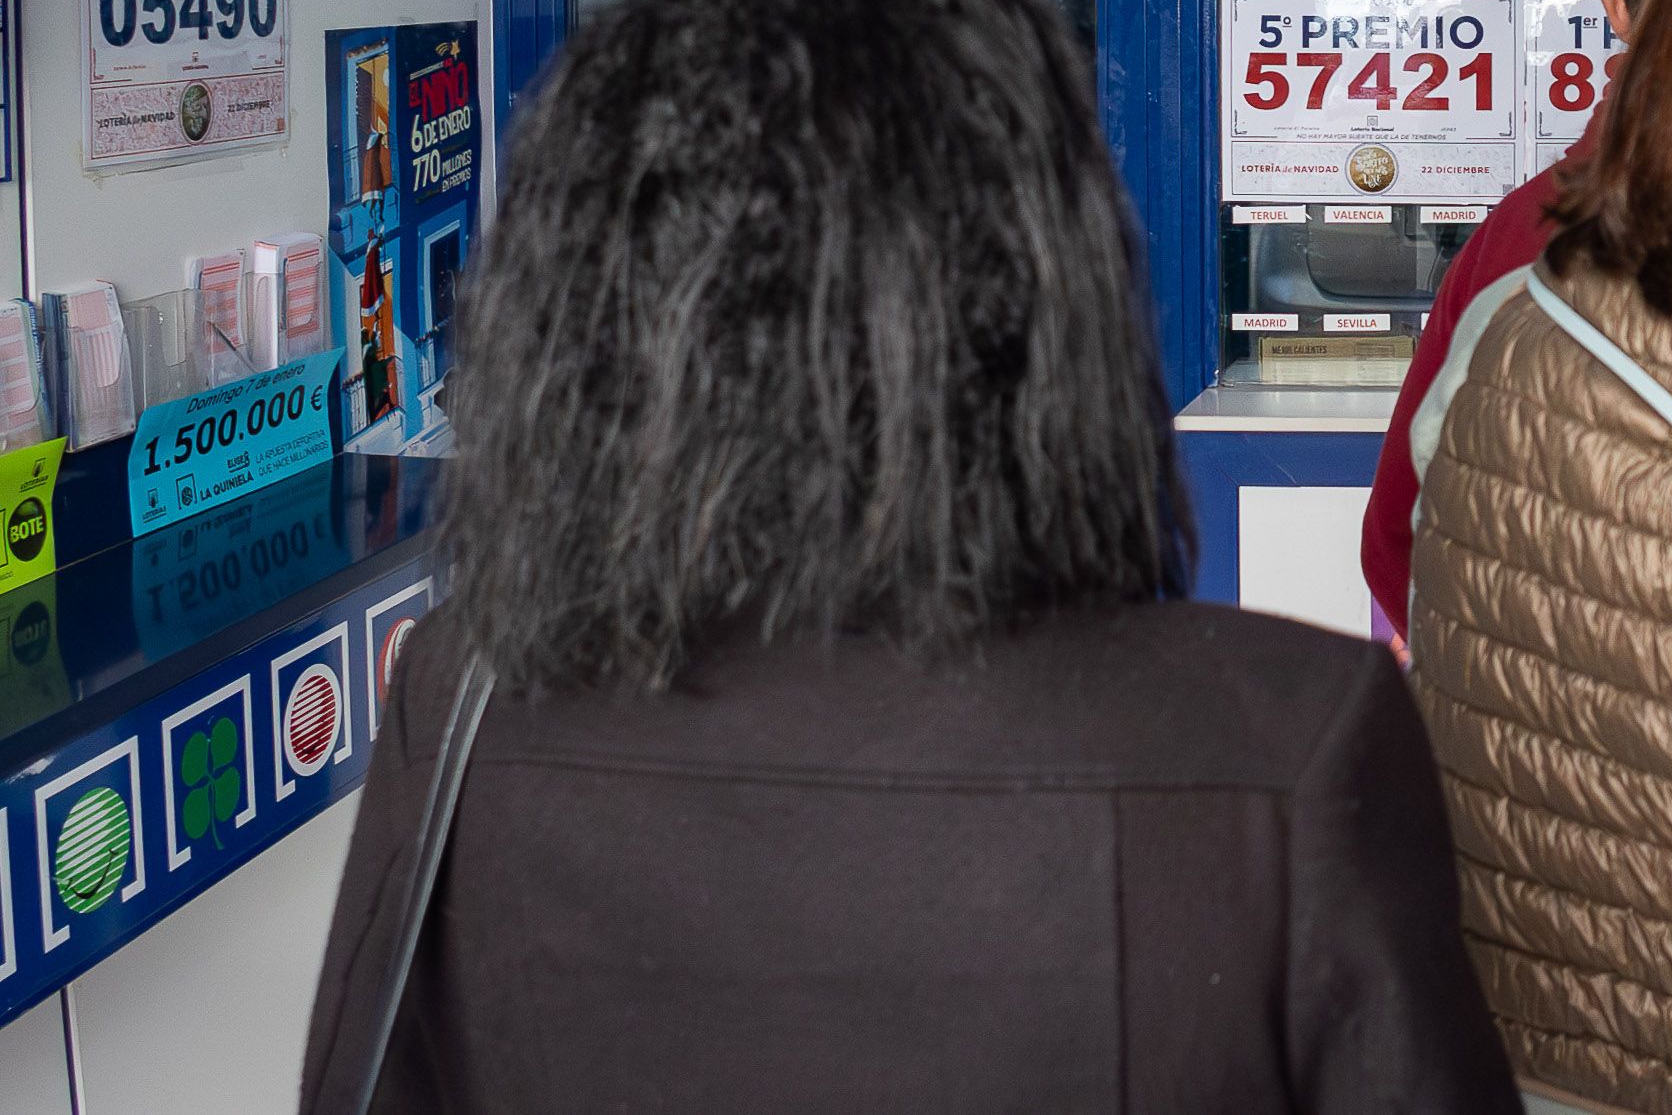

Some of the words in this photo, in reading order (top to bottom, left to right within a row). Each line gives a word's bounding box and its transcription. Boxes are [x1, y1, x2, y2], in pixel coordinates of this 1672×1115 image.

[1302, 14, 1485, 50] PREMIO
[1568, 15, 1598, 49] 1er
[1243, 52, 1494, 112] 57421
[411, 114, 423, 153] 6
[424, 123, 439, 147] DE
[438, 105, 471, 140] ENERO
[412, 148, 441, 192] 770
[1241, 162, 1281, 173] LOTERÍA
[1293, 165, 1339, 173] NAVIDAD
[1421, 166, 1433, 174] 22
[1435, 166, 1490, 174] DICIEMBRE
[1250, 210, 1289, 221] TERUEL
[1333, 210, 1384, 220] VALENCIA
[1432, 209, 1476, 220] MADRID
[1244, 319, 1287, 328] MADRID
[1337, 319, 1377, 328] SEVILLA
[186, 385, 244, 415] Domingo
[256, 374, 271, 391] de
[272, 363, 305, 385] enero
[143, 384, 305, 477] 1.500.000
[199, 488, 213, 502] LA
[213, 471, 254, 495] QUINIELA
[9, 515, 45, 544] BOTE
